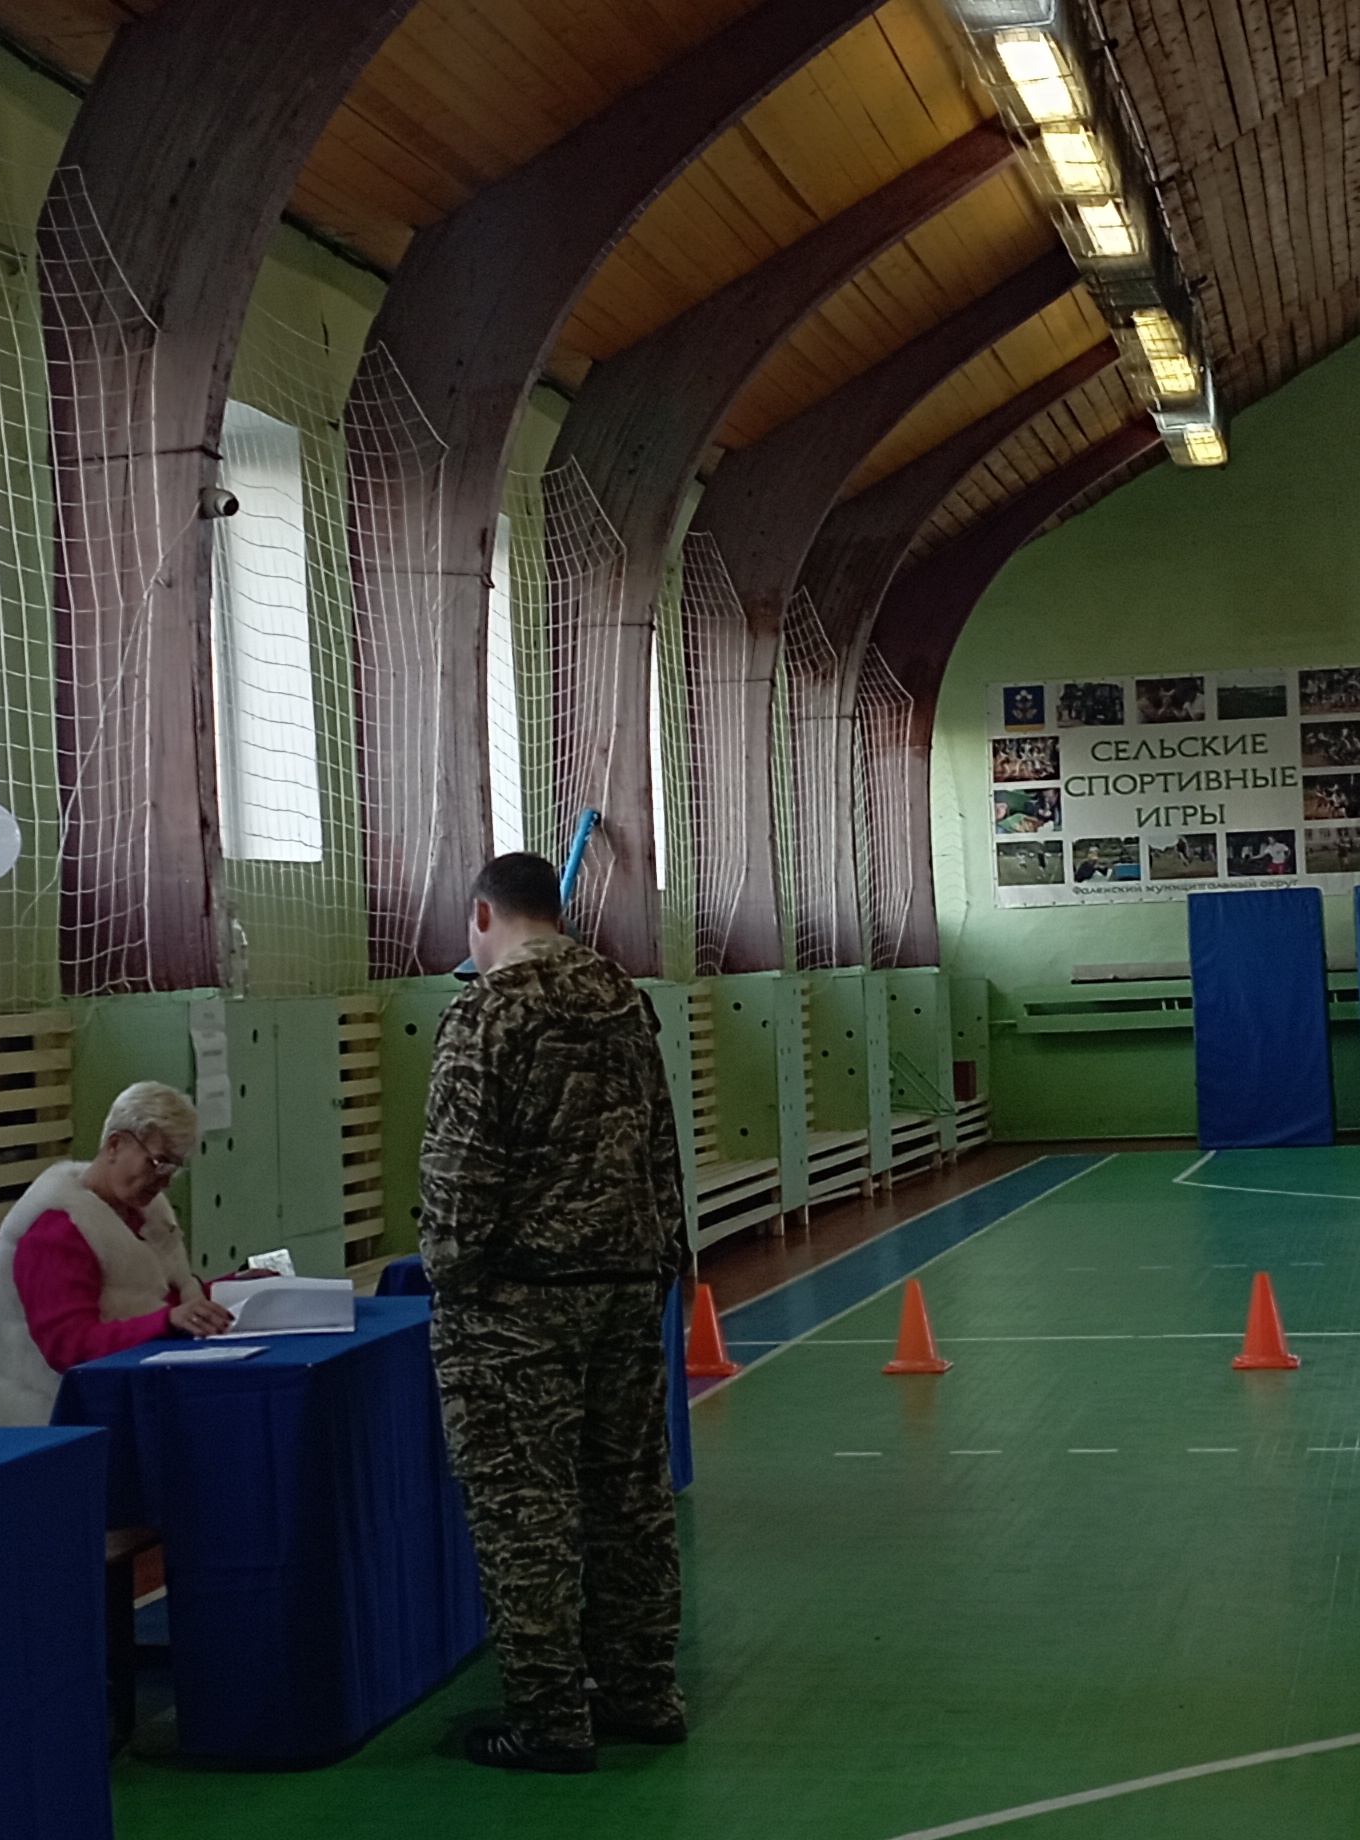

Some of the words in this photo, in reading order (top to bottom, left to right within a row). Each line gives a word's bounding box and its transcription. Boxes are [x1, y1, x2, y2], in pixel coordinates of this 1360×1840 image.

[1090, 733, 1268, 762] СЕЛЬСКИЕ
[1064, 766, 1299, 797] СПОРТИВНЫЕ
[1136, 803, 1226, 828] ИГРЫ
